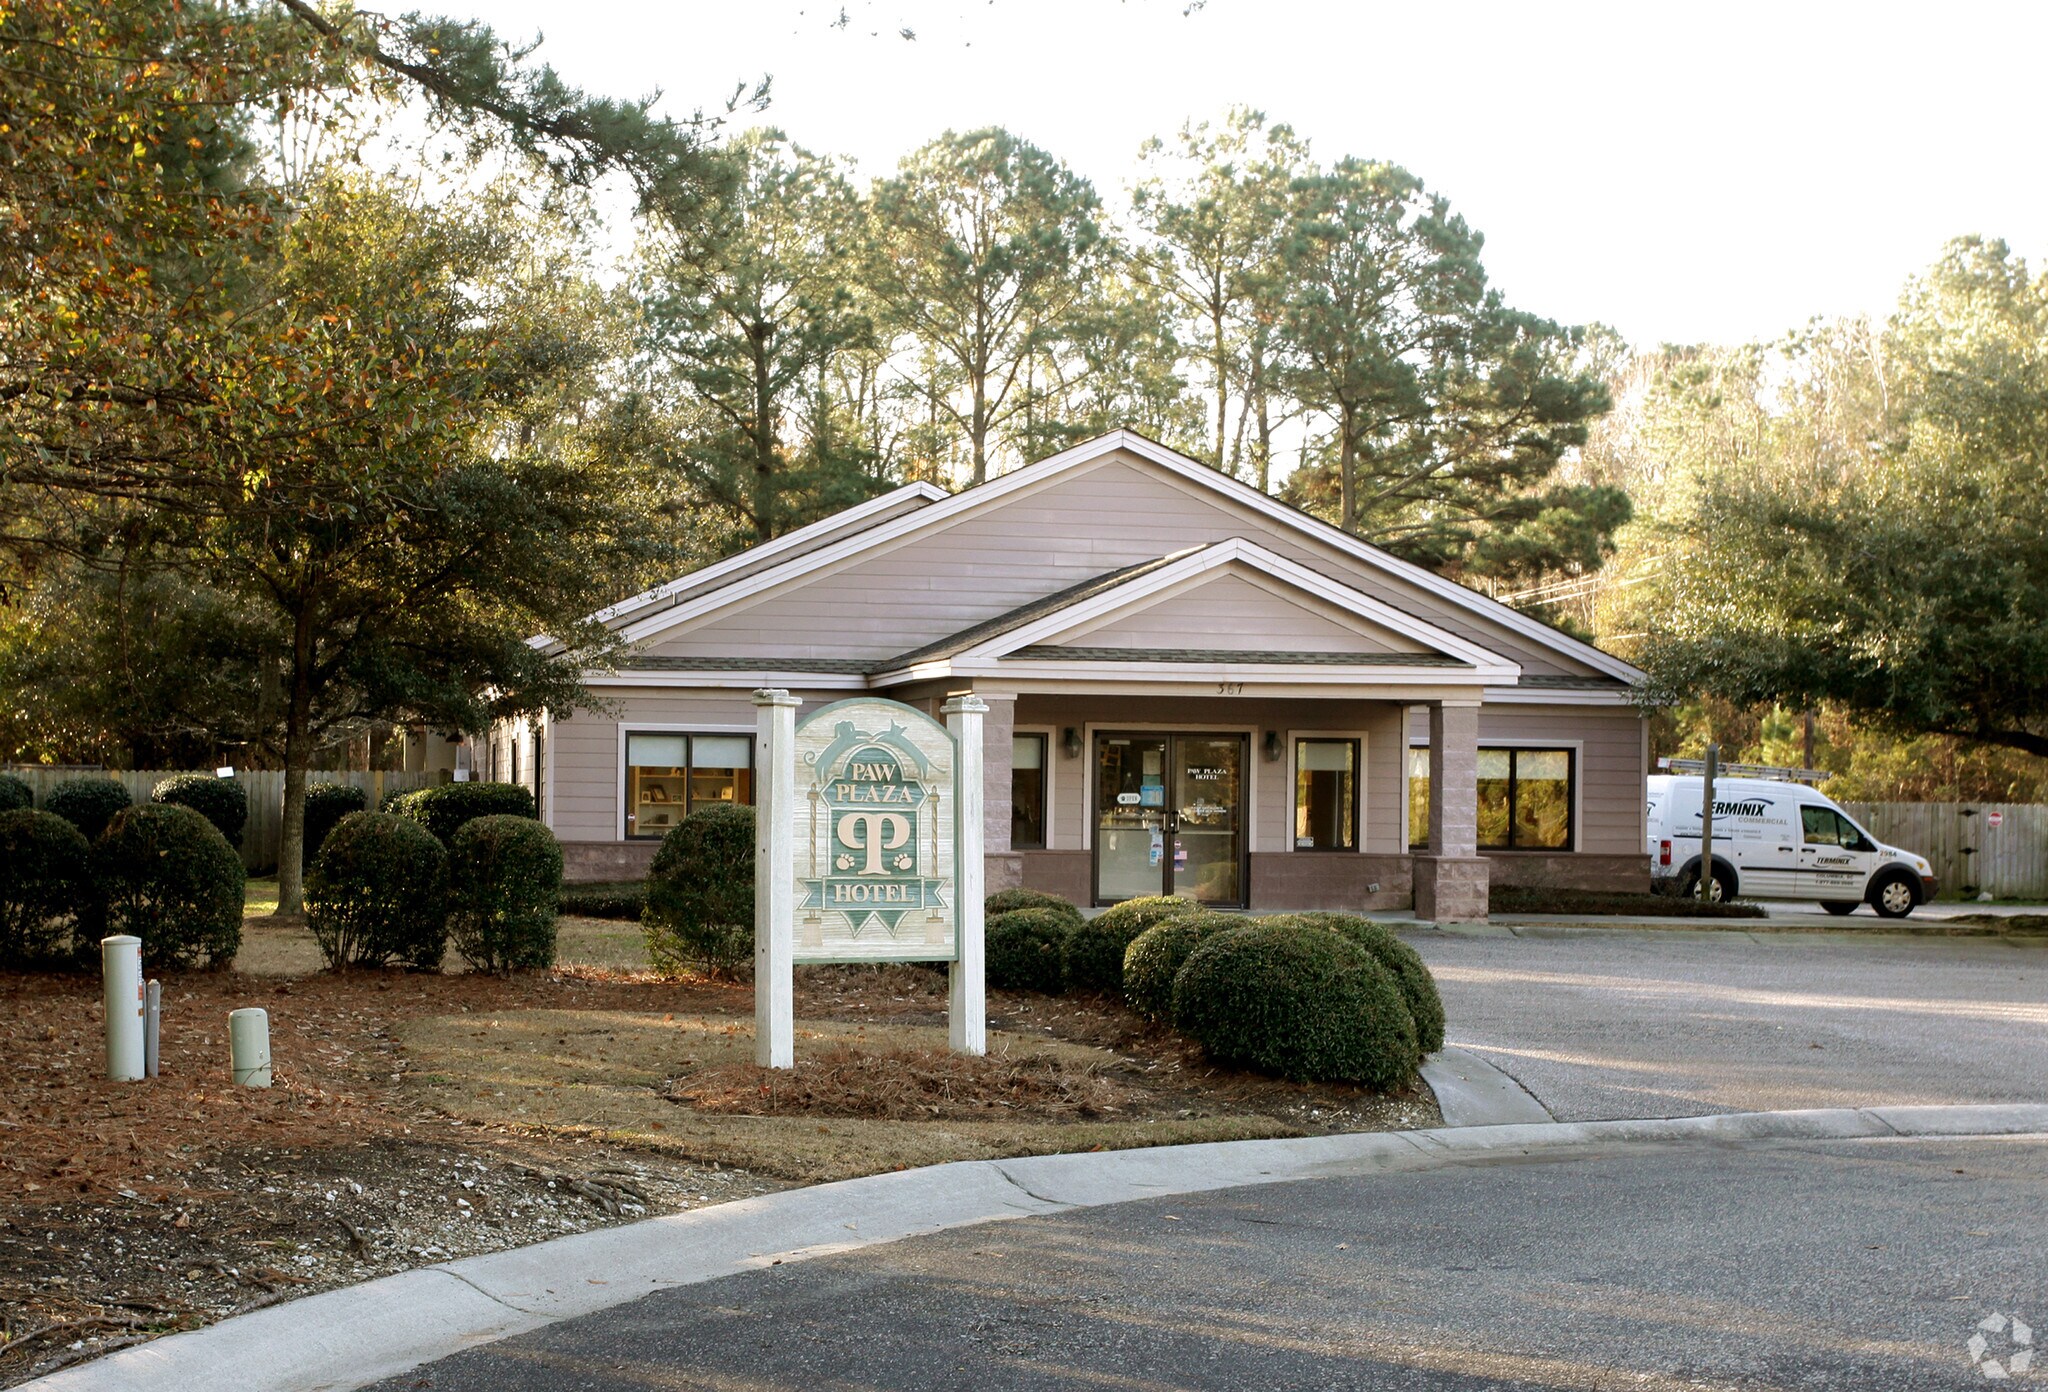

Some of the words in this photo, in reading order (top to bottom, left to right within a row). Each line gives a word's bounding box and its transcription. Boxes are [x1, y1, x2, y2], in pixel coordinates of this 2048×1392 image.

[1216, 682, 1244, 696] 367
[850, 762, 897, 782] PAW
[835, 783, 914, 804] PLAZA
[1702, 801, 1766, 817] ERMINIX
[1737, 816, 1789, 826] COMMERCIAL
[1816, 856, 1851, 866] TERMINIX
[834, 884, 915, 904] HOTEL
